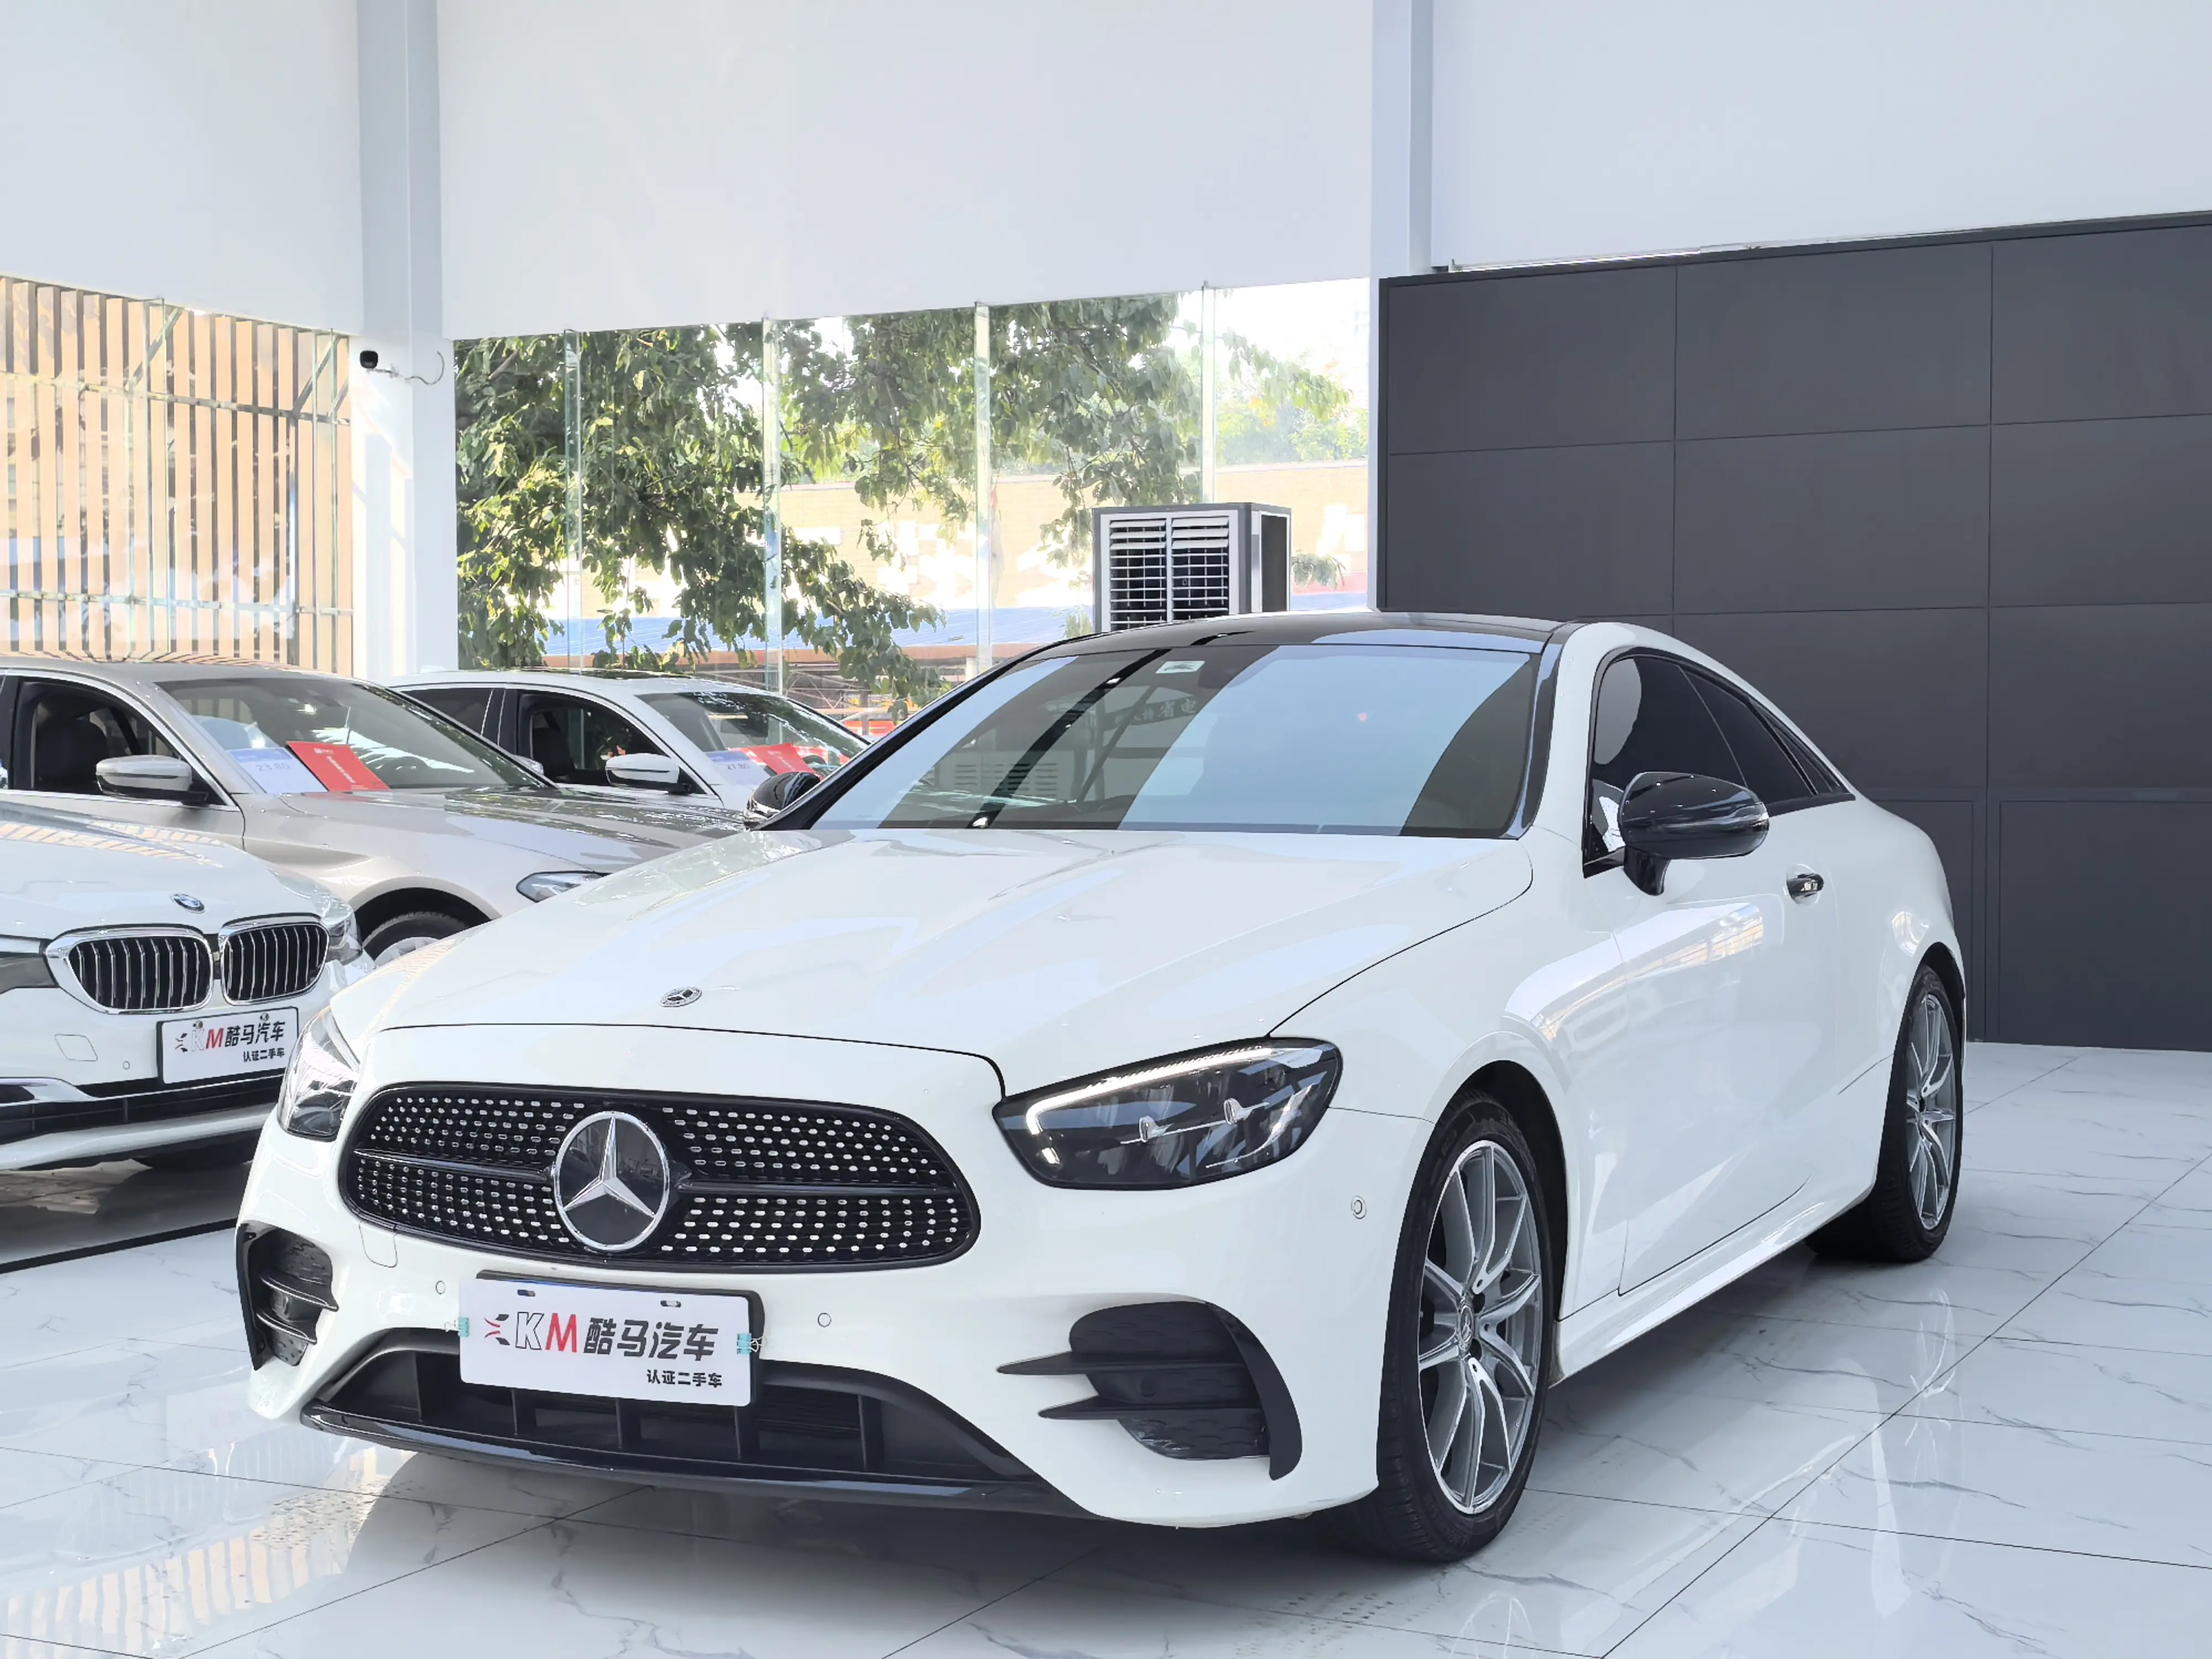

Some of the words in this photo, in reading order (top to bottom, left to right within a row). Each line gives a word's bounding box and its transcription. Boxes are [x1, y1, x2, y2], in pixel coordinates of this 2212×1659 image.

[243, 1047, 285, 1062] 认证二手车
[646, 1369, 722, 1388] 认证二手车
